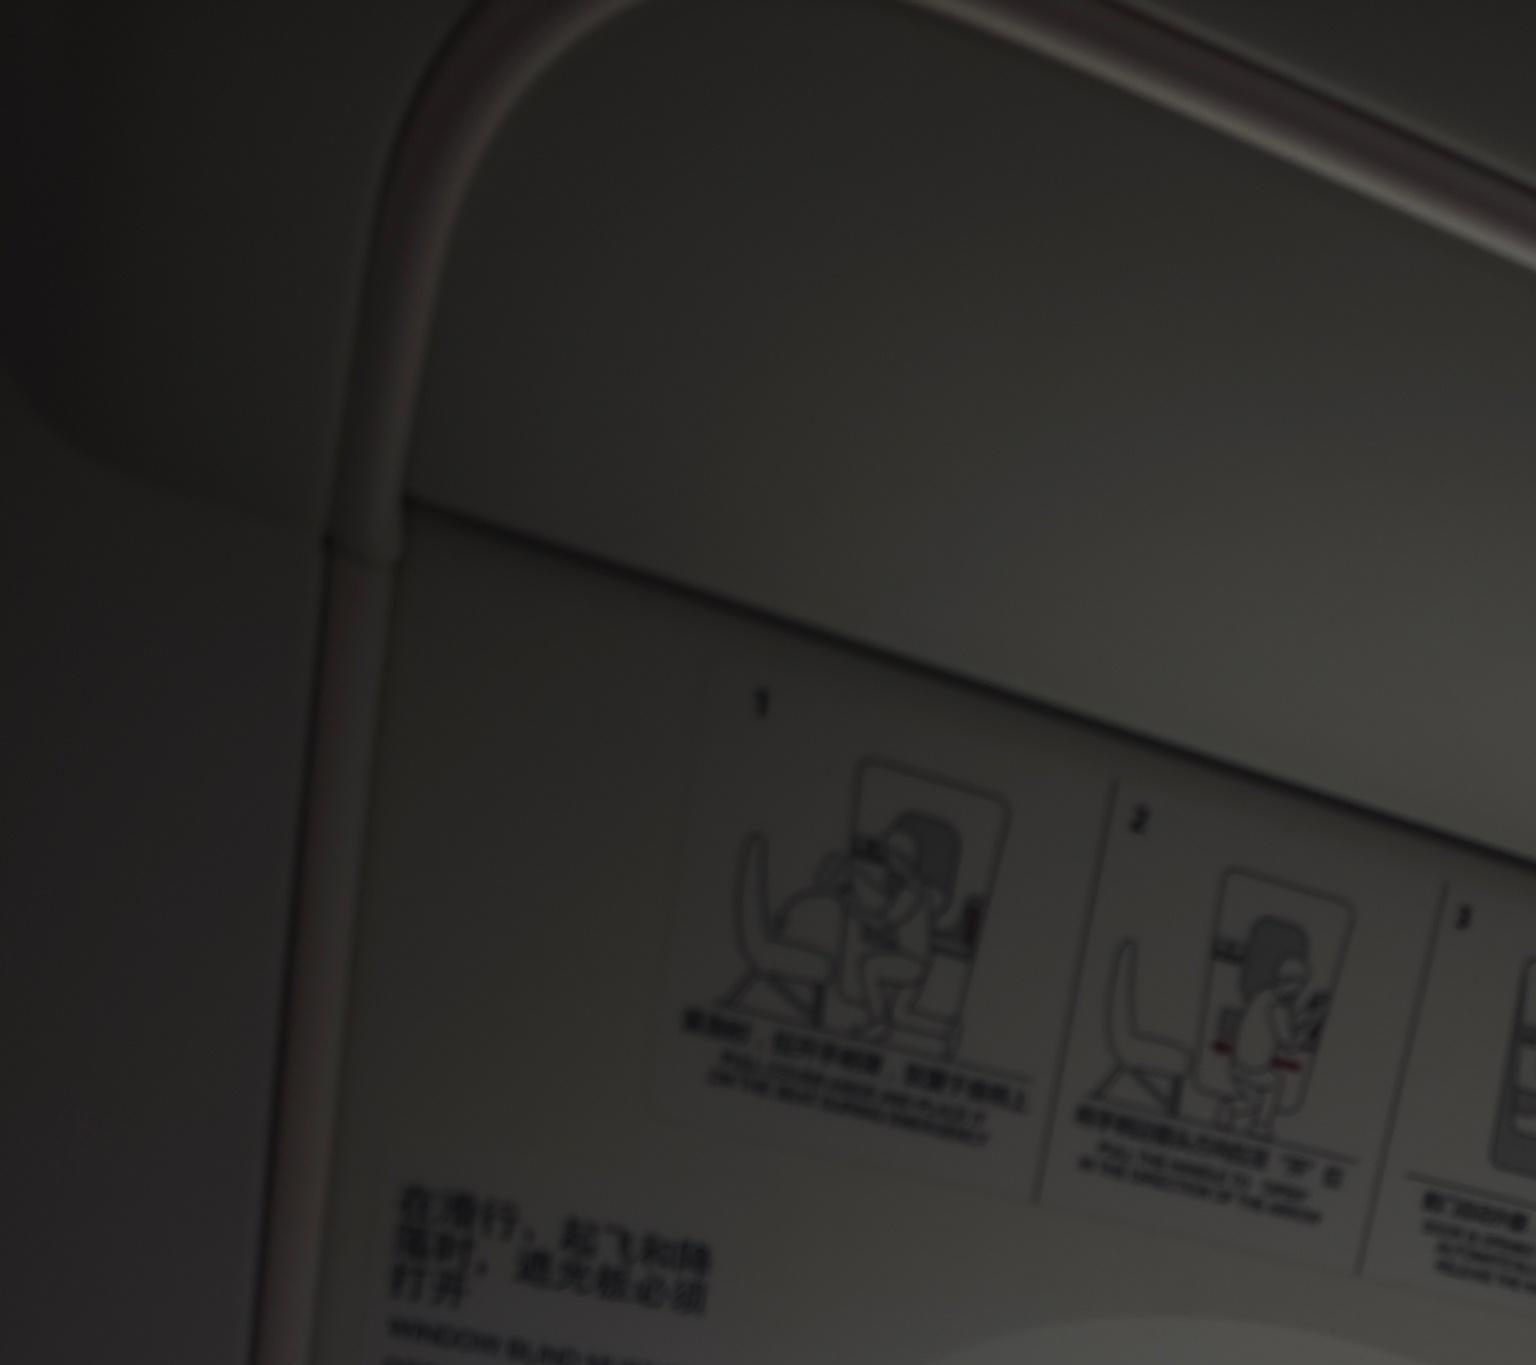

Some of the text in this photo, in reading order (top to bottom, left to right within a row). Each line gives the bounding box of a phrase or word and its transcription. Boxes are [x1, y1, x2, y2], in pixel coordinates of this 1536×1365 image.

[752, 684, 772, 720] 1
[1128, 802, 1153, 836] 2
[388, 1259, 469, 1311] 打开
[385, 1315, 503, 1357] WINDOW
